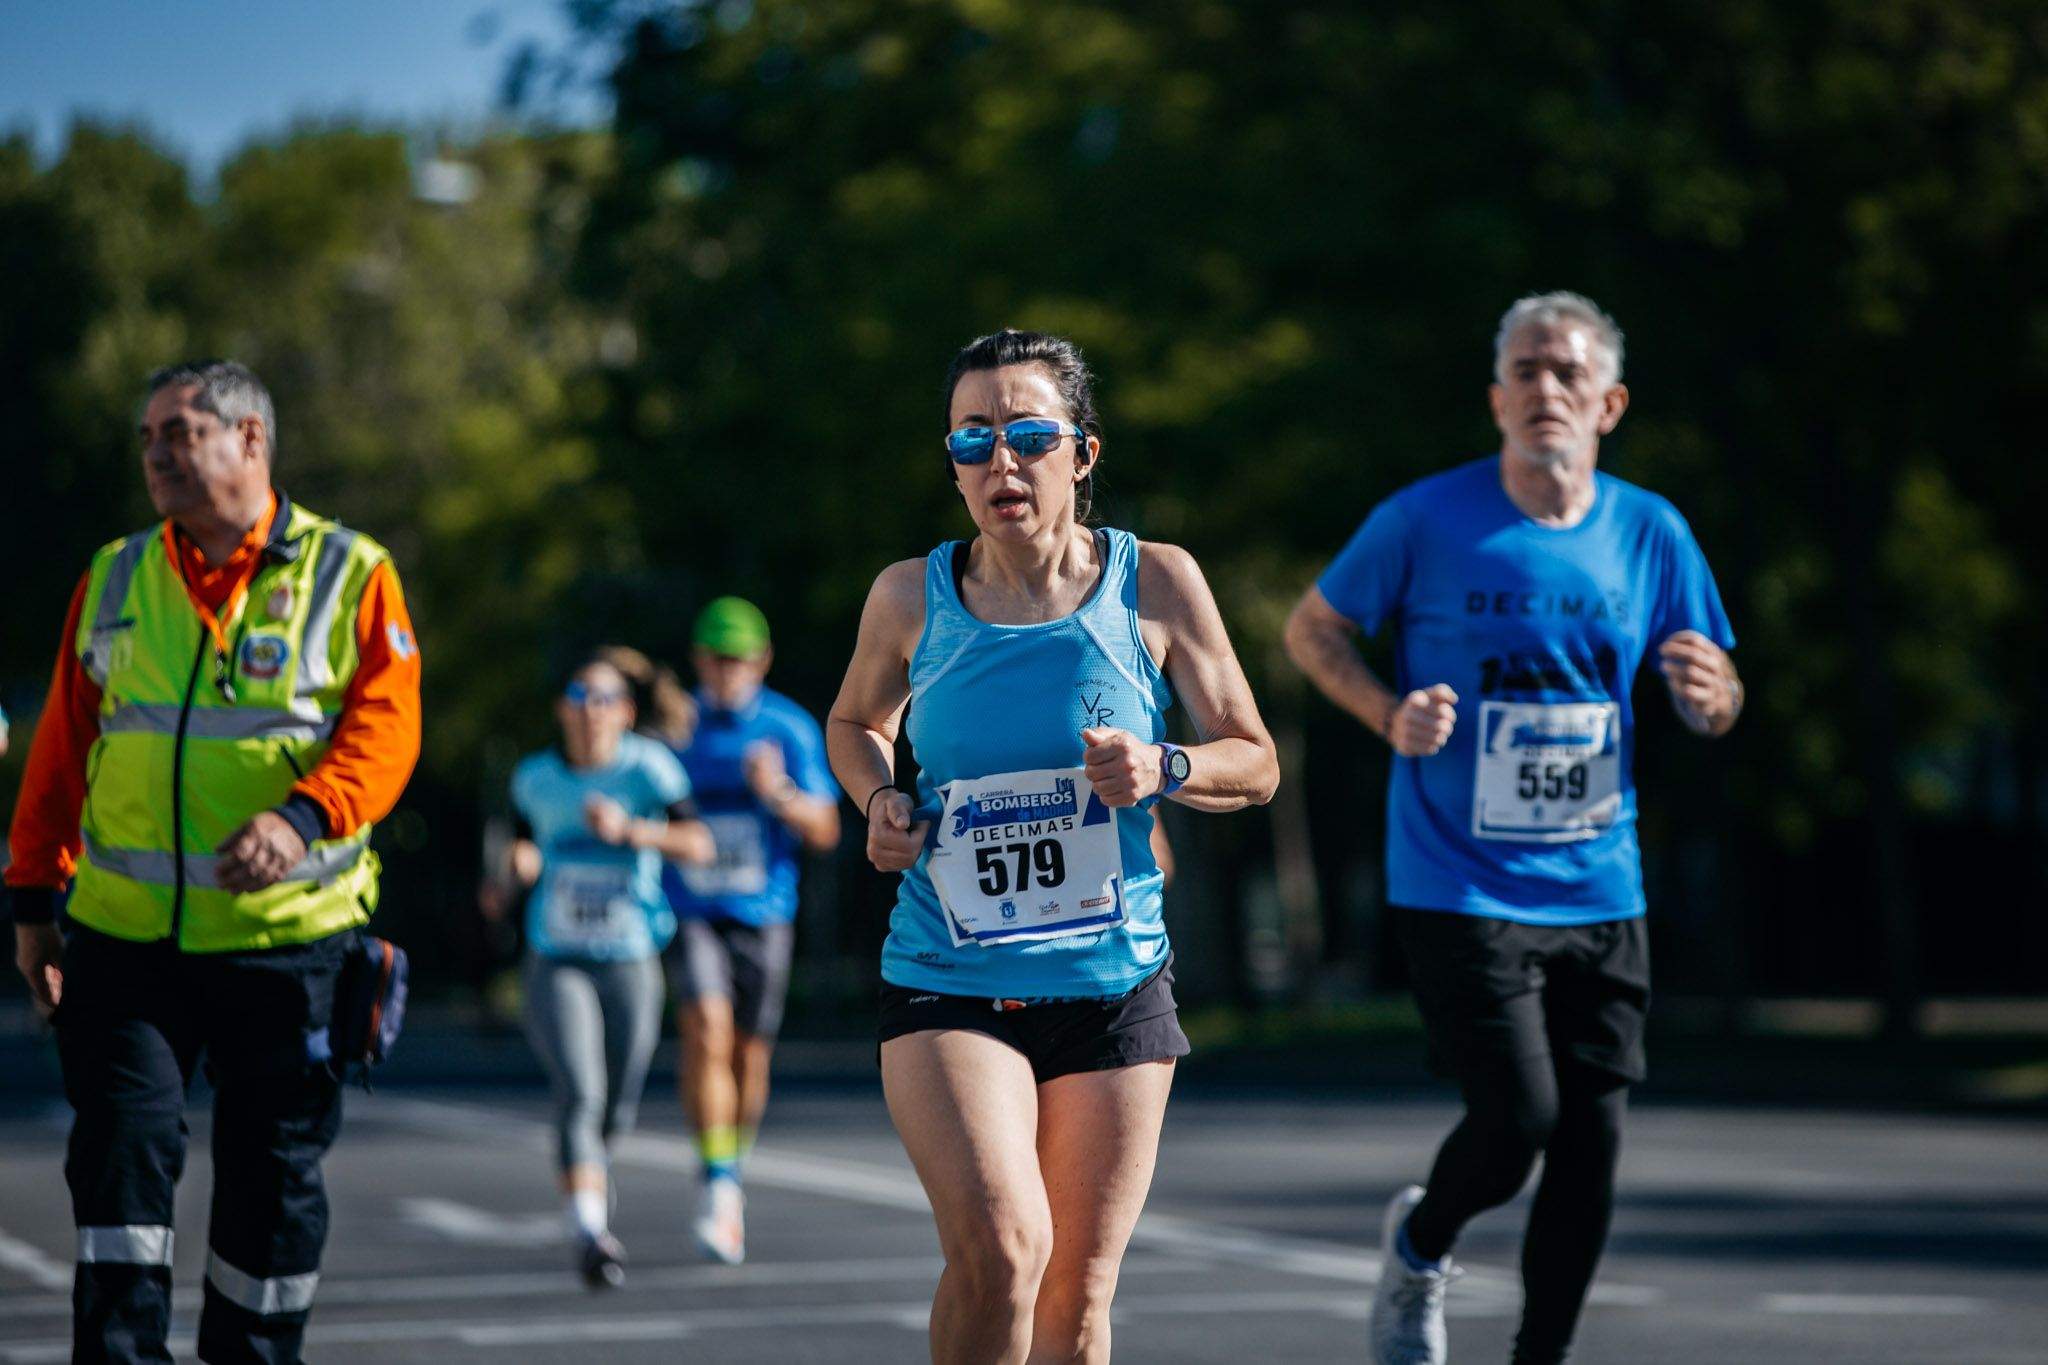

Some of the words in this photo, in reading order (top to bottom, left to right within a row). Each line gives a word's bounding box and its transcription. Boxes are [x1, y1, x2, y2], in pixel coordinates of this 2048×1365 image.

[1467, 591, 1630, 623] DECIMAS
[980, 789, 1014, 799] CARRERA
[1518, 763, 1588, 800] 559
[981, 791, 1072, 813] BOMBEROS
[1017, 809, 1030, 822] de
[1033, 803, 1074, 819] MADRID
[973, 817, 1074, 842] DECIMAS
[975, 837, 1067, 897] 579
